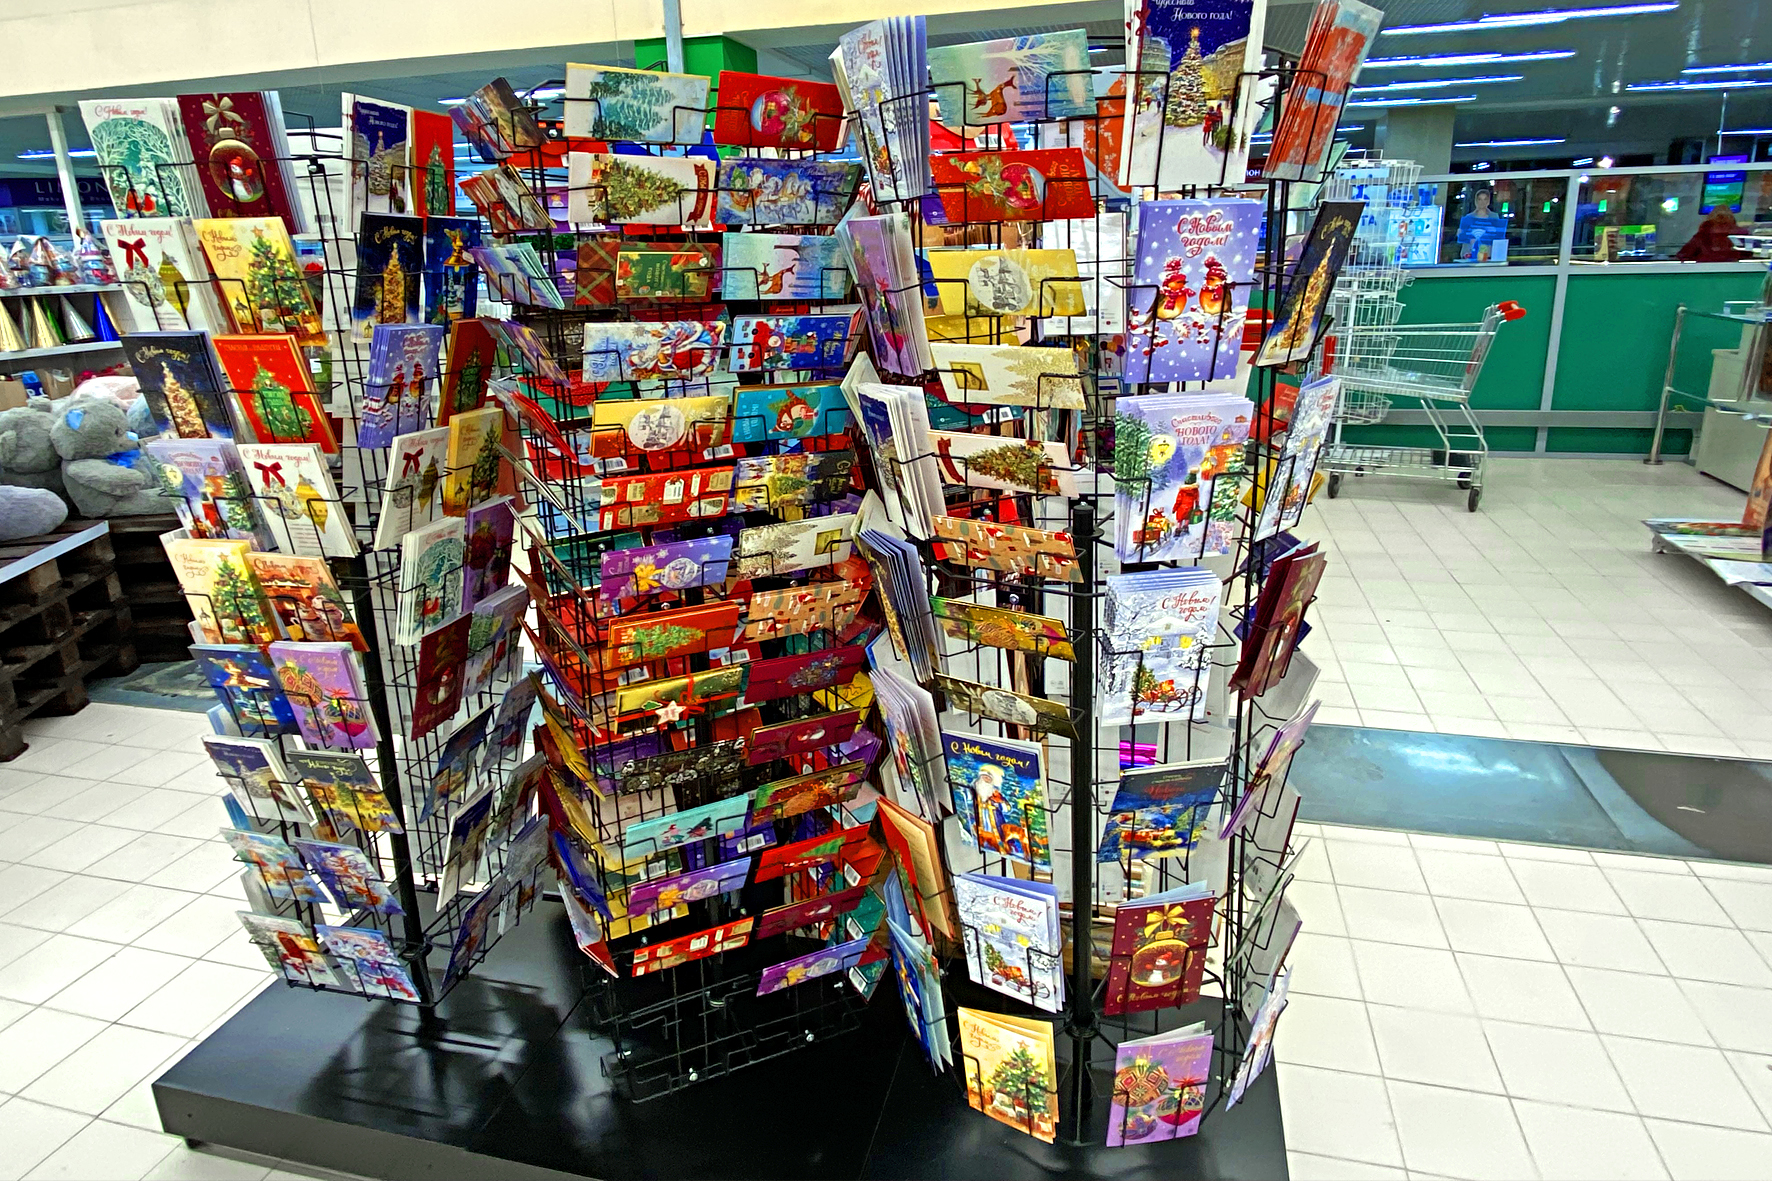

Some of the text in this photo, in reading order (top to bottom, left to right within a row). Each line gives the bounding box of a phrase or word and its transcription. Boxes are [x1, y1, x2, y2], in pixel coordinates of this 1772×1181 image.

[1170, 7, 1208, 21] Нового
[1177, 211, 1232, 236] С Новым
[1181, 235, 1229, 258] годом!
[1175, 426, 1218, 437] НОВОГО
[1182, 435, 1210, 446] ГОДА!
[1162, 598, 1170, 609] С
[951, 741, 1030, 769] С Новым годом!
[993, 896, 1000, 906] С
[1116, 995, 1124, 1003] С
